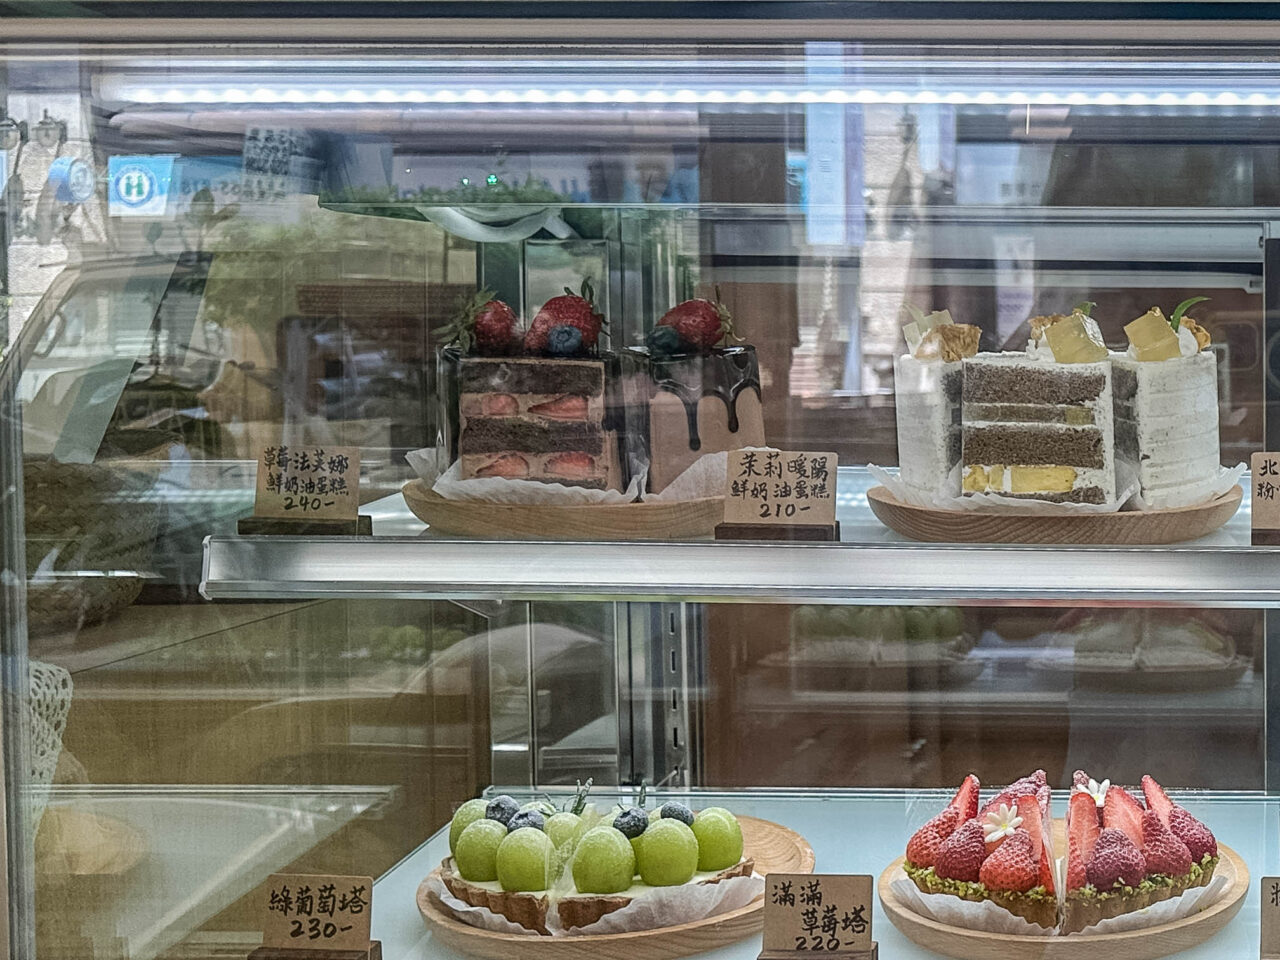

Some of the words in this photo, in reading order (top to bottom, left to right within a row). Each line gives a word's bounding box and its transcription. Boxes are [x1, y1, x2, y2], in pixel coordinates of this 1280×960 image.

[738, 452, 829, 482] 茉莉暖陽
[266, 472, 349, 496] 鮮奶油蛋糕
[731, 479, 830, 501] 鮮奶油蛋糕
[269, 884, 369, 918] 綠葡萄塔
[772, 879, 823, 908] 滿滿
[801, 904, 869, 937] 草莓塔
